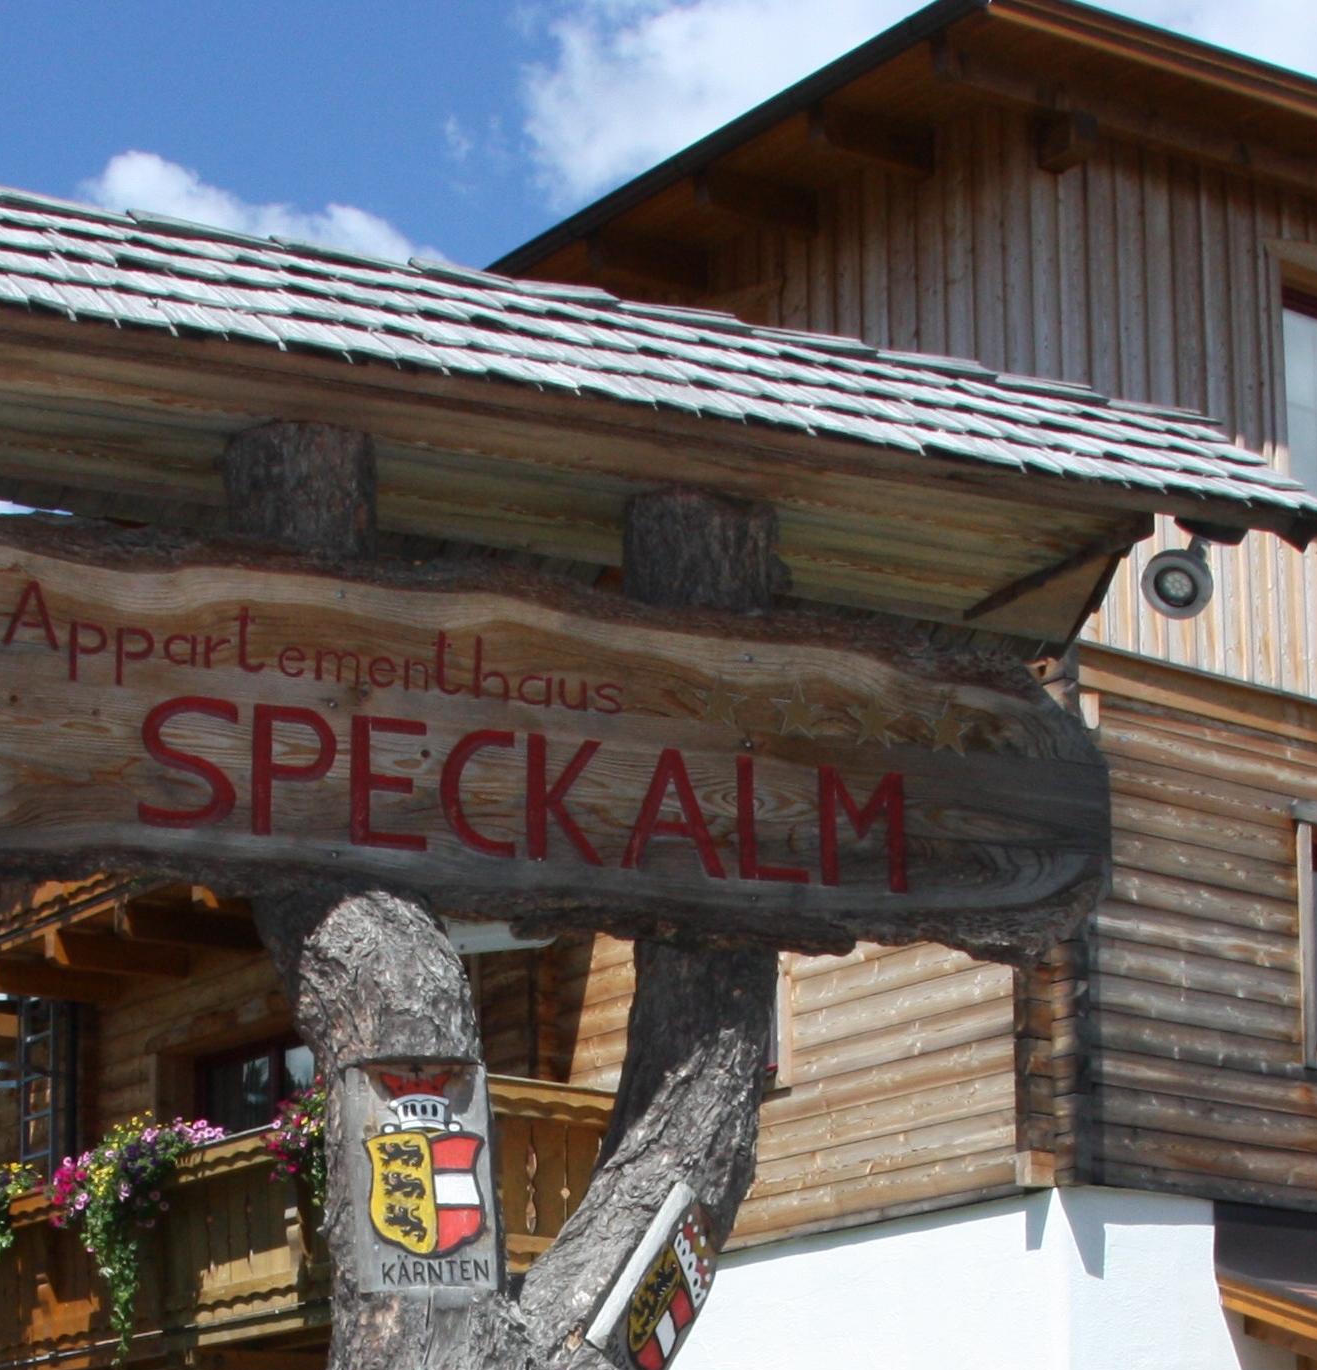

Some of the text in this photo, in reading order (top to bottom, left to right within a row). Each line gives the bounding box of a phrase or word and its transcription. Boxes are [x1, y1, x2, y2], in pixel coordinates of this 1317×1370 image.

[3, 579, 626, 717] Appartementhaus
[137, 695, 909, 894] SPECKALM
[381, 1257, 491, 1288] KÄRNTEN
